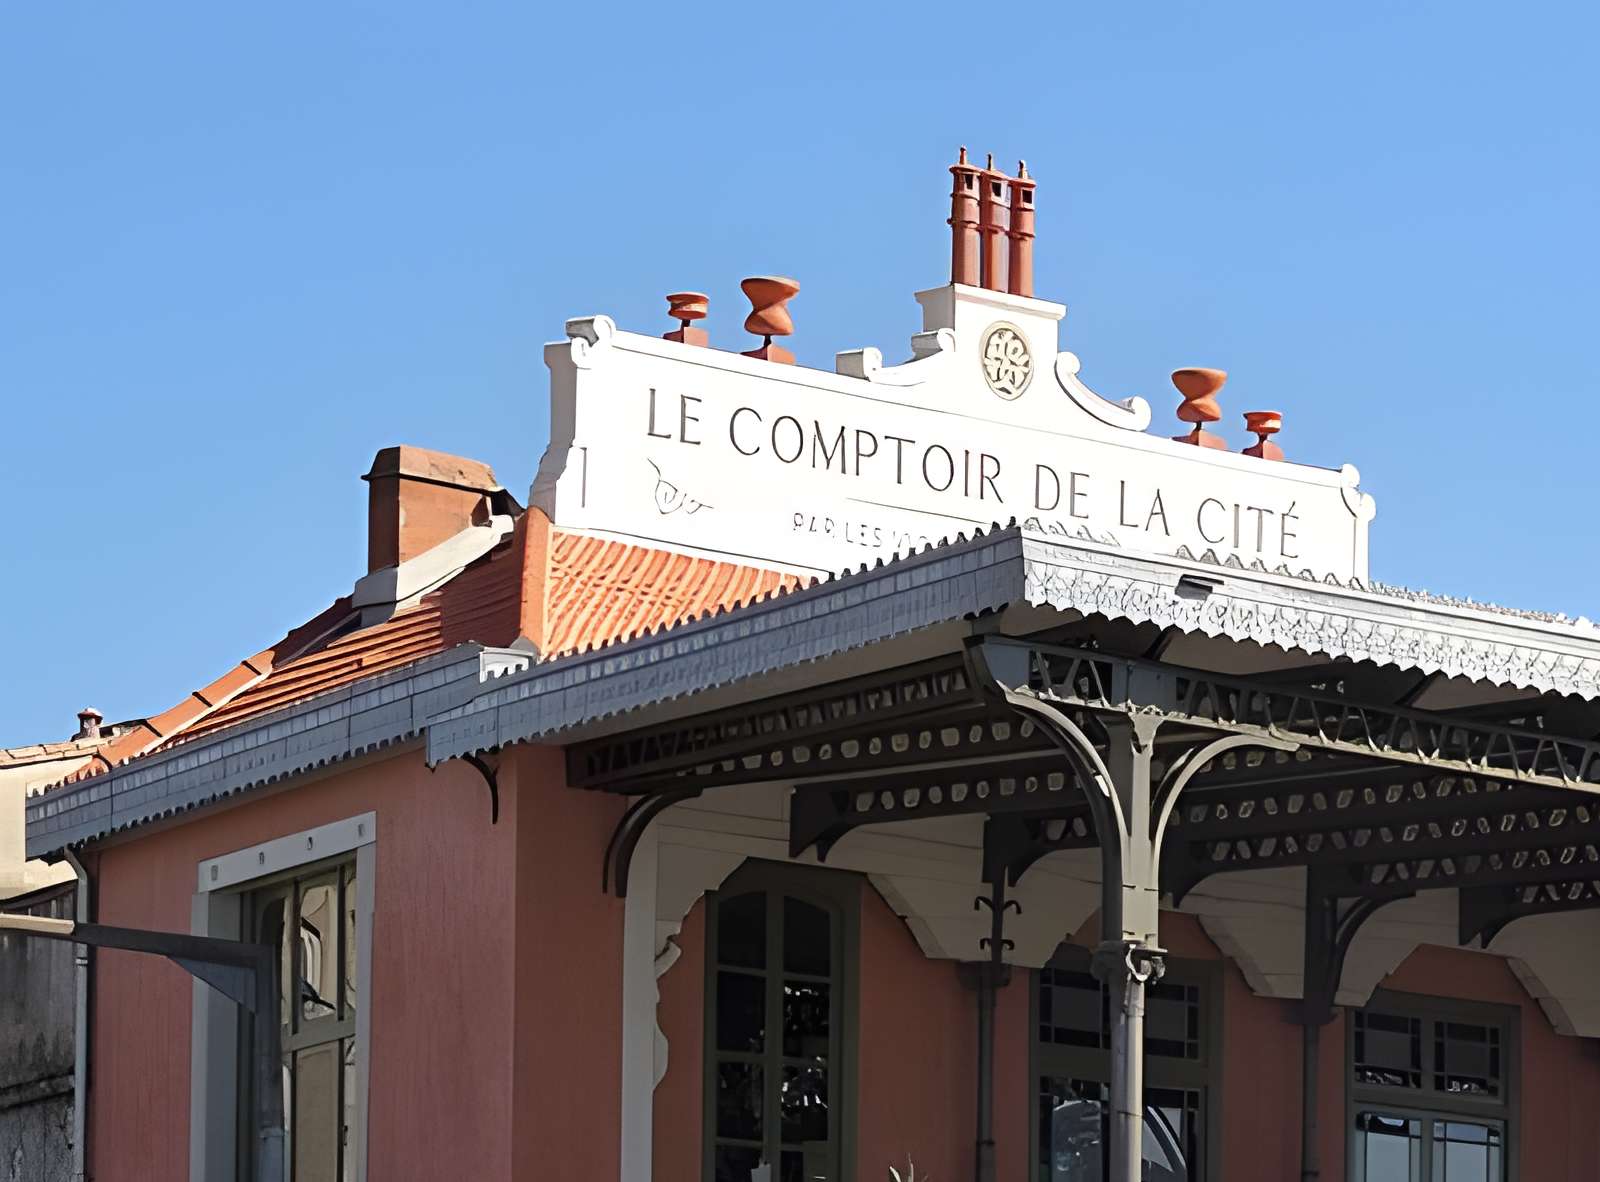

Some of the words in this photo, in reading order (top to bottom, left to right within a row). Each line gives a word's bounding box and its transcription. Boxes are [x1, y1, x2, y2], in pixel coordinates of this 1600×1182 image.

[647, 387, 703, 446] LE
[729, 406, 1004, 504] COMPTOIR
[1034, 463, 1090, 520] DE
[1119, 479, 1171, 537] LA
[1196, 500, 1300, 559] CITÉ
